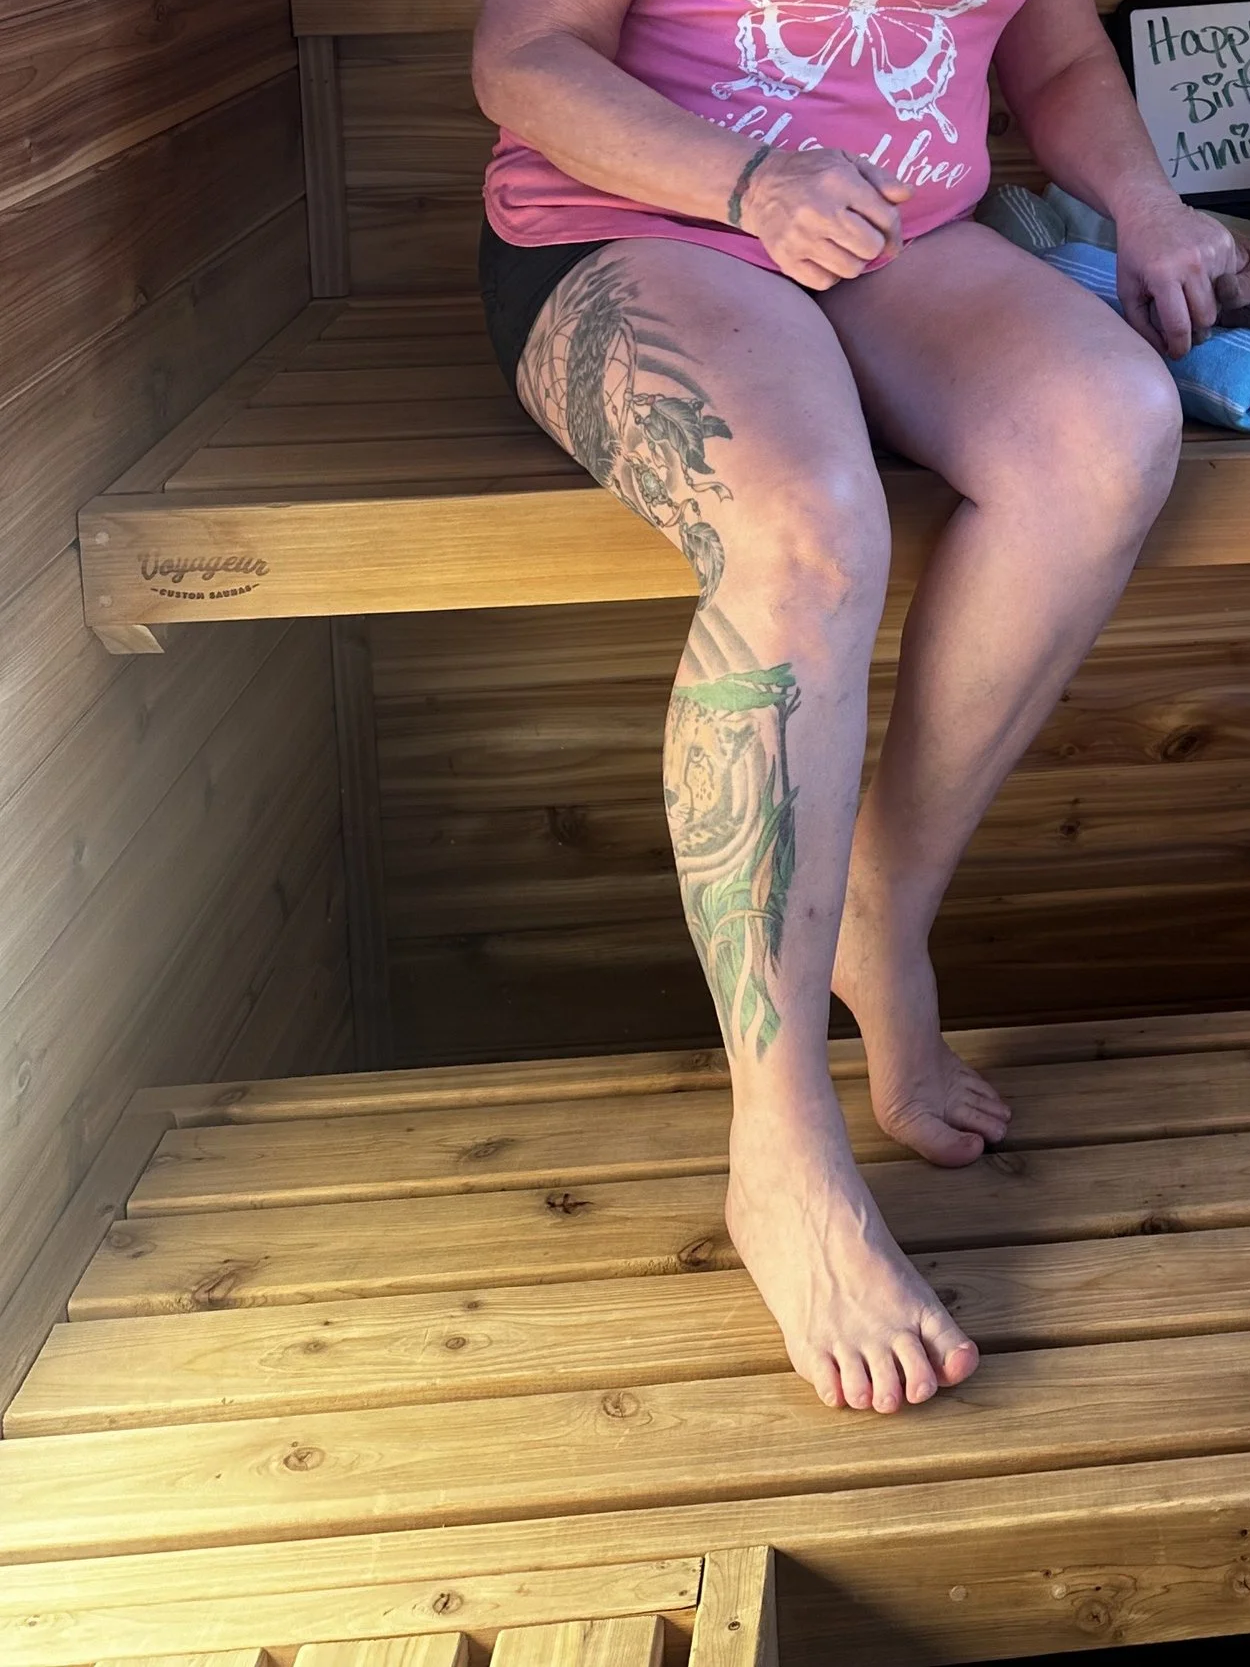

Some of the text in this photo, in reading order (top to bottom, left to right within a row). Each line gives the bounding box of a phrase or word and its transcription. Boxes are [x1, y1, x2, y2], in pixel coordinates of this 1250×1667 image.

[138, 553, 270, 583] Voyageur
[159, 584, 252, 600] CUSTOM SAUNAS
